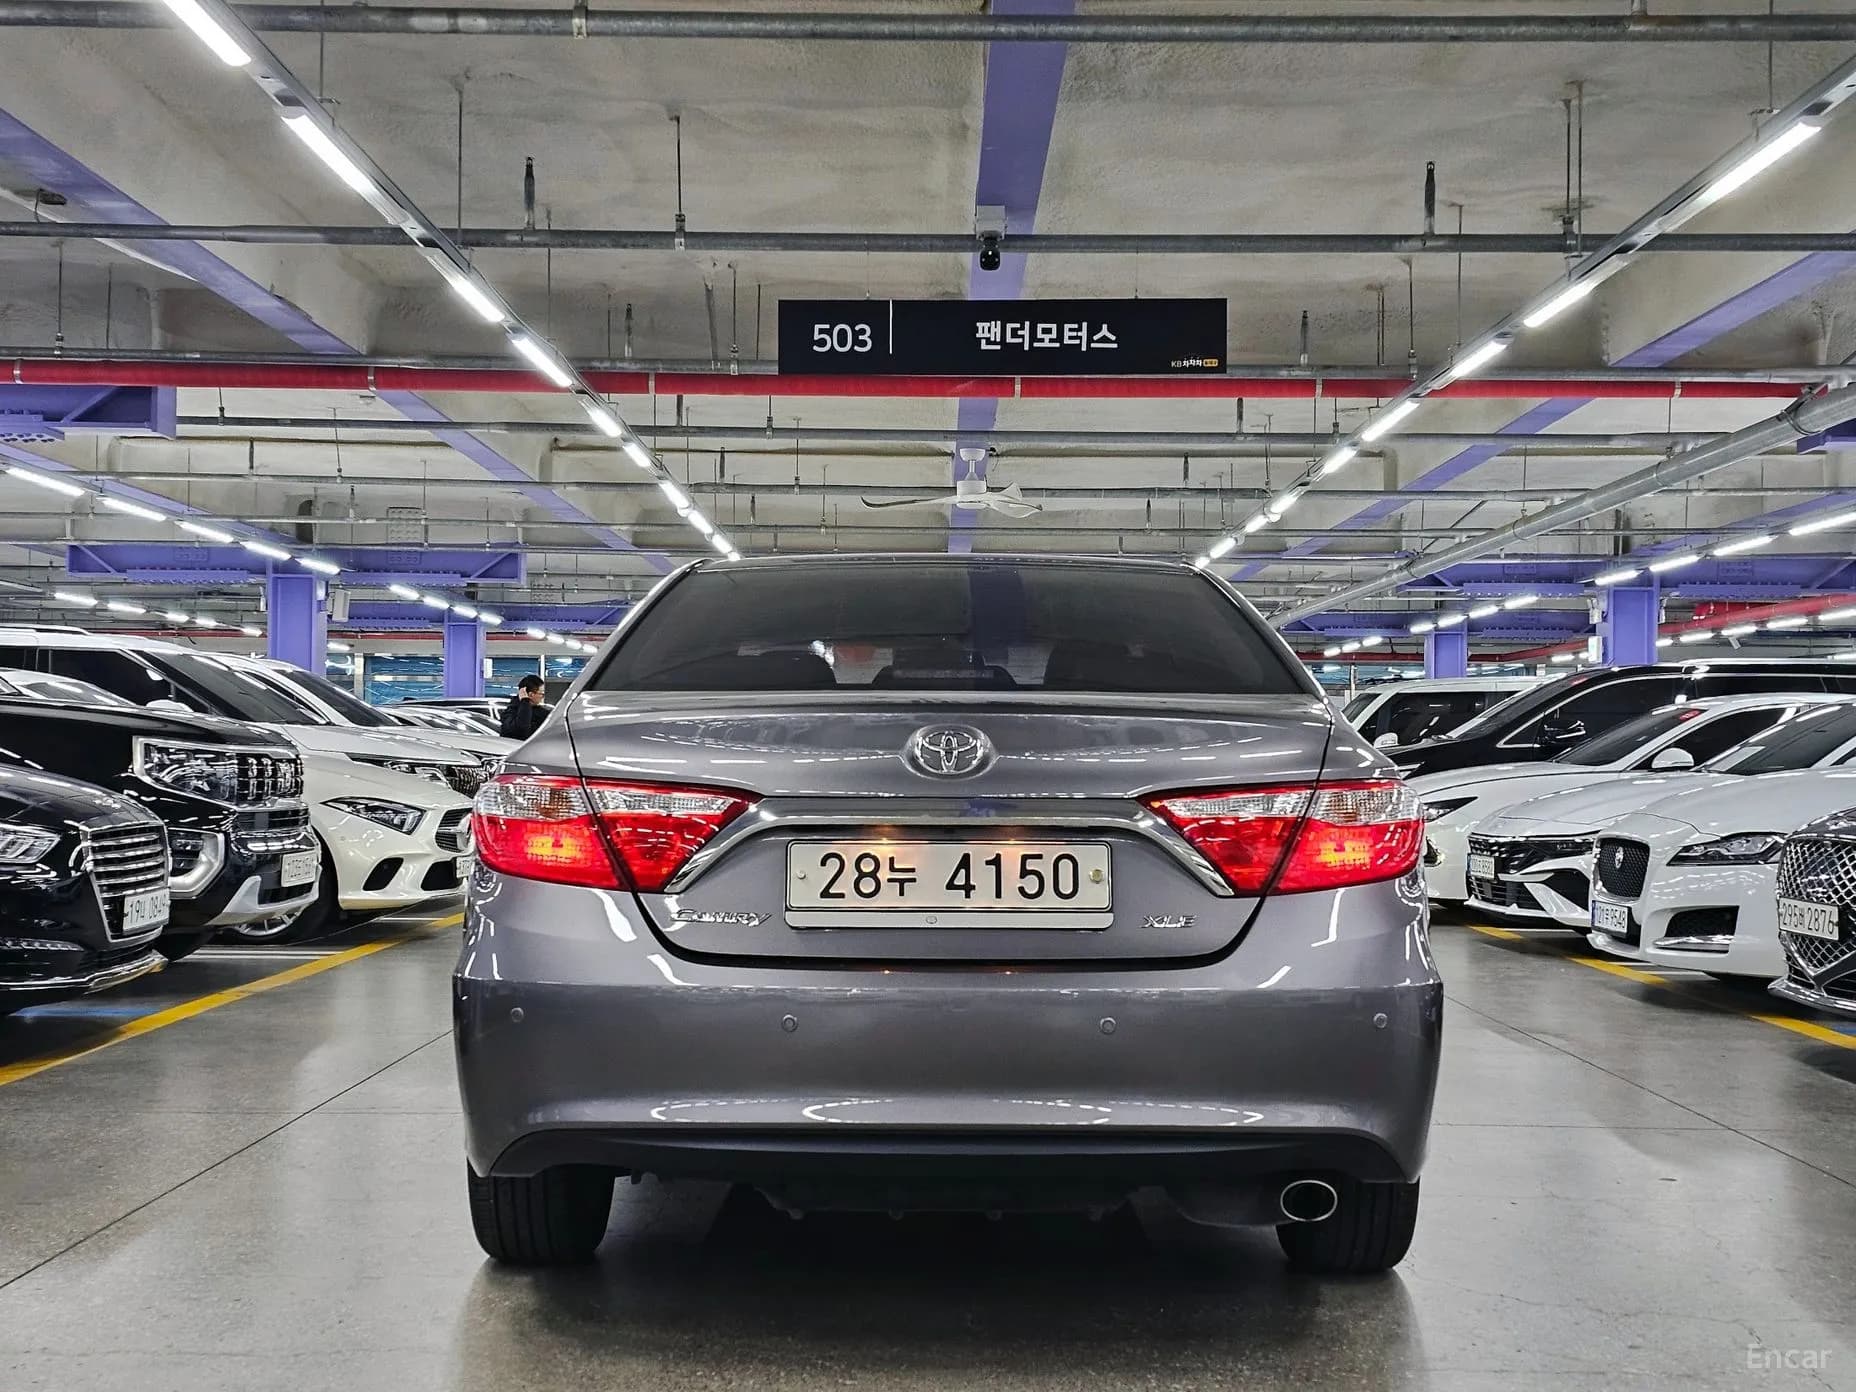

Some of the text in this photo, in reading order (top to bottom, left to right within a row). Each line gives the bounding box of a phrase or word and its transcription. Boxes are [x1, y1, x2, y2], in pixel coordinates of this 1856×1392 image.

[812, 323, 872, 352] 503
[975, 320, 1118, 351] 팬더모터스
[819, 852, 1080, 900] 28누 4150
[1140, 915, 1197, 928] XLE
[1807, 907, 1835, 935] 2876
